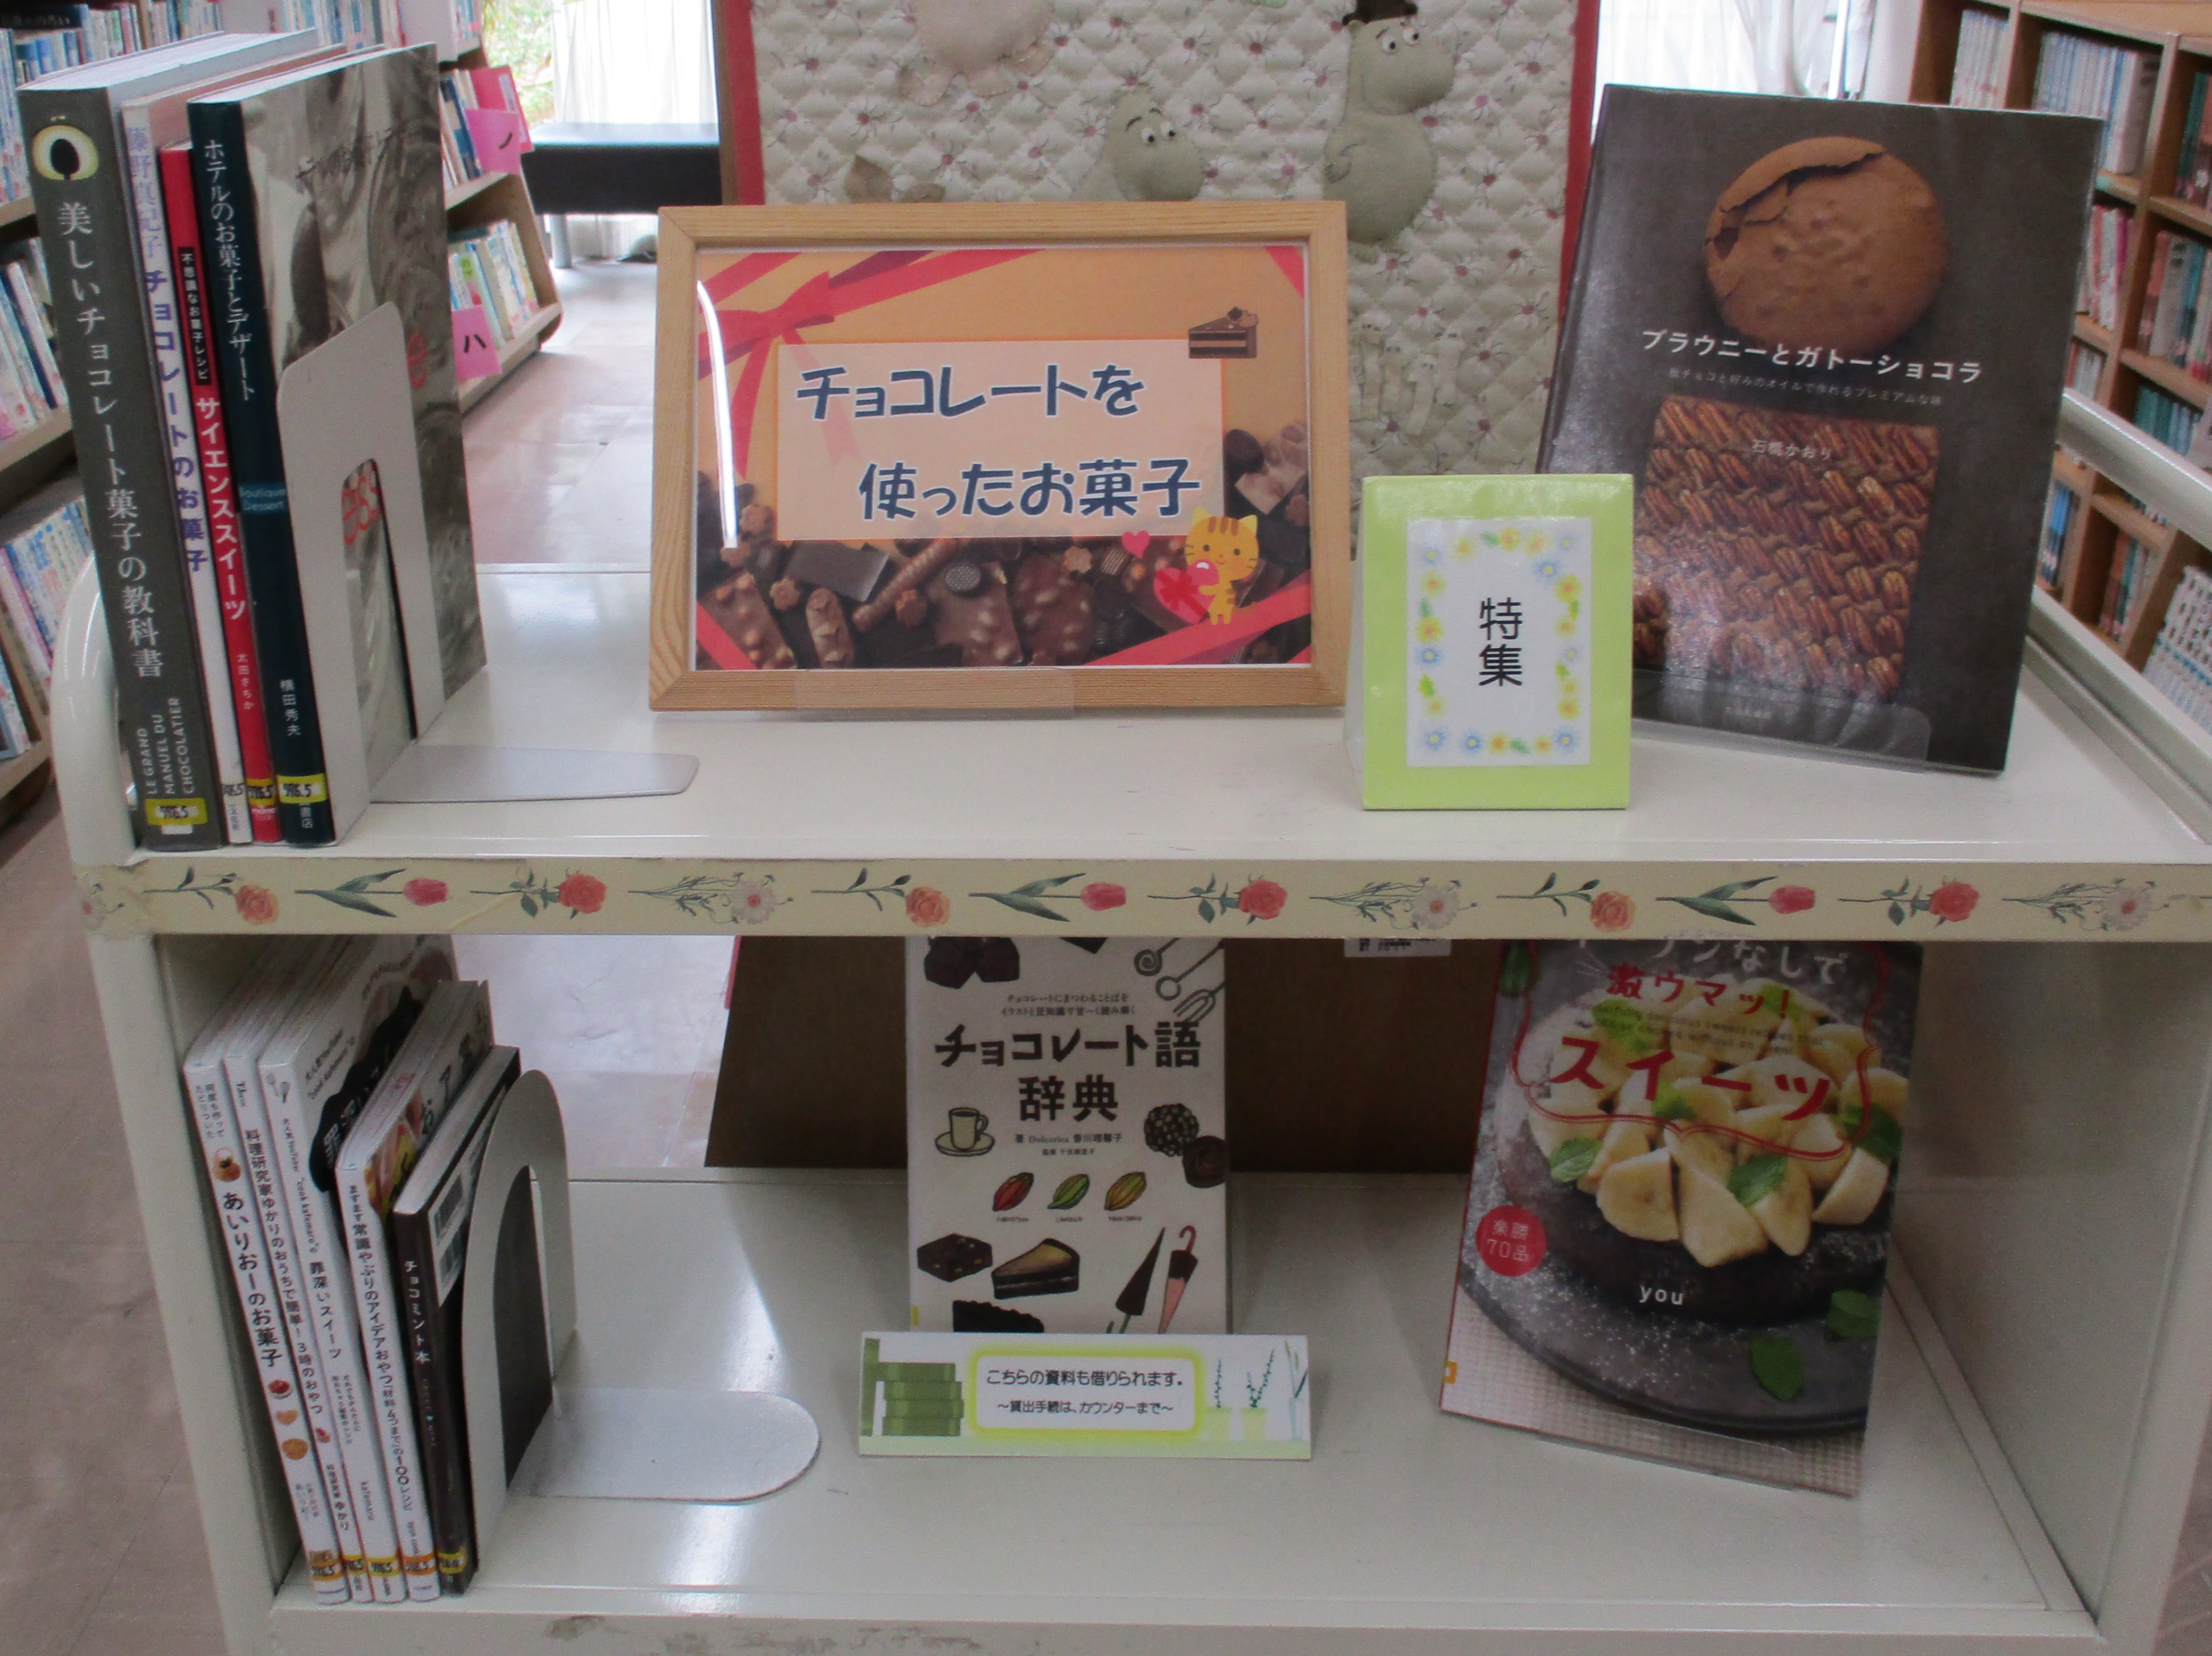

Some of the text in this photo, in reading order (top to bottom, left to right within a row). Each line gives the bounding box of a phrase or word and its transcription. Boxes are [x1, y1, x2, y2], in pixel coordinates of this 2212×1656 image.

[204, 139, 255, 402] ホテルのお菓子とデザート
[796, 364, 1145, 420] チョコレートを
[1642, 329, 1982, 383] ブラウニーとガトーショコラ
[58, 202, 163, 678] 美しいチョコレート菓子の教科書
[145, 269, 210, 573] チョコレートのお菓子
[196, 398, 247, 621] サイエンススイーツ
[858, 458, 1201, 520] 使ったお菓子
[1478, 597, 1523, 688] 特集
[136, 727, 154, 776] GRAND
[152, 714, 175, 794] MANUEL DU
[167, 698, 196, 794] CHOCOLATIER
[934, 1022, 1201, 1068] チョコレート語
[1550, 1036, 1831, 1121] スイーツ
[1018, 1074, 1119, 1122] 辞典
[223, 1191, 283, 1368] あいりおーのお菓子
[1486, 1237, 1530, 1262] 70品
[1639, 1285, 1685, 1306] you
